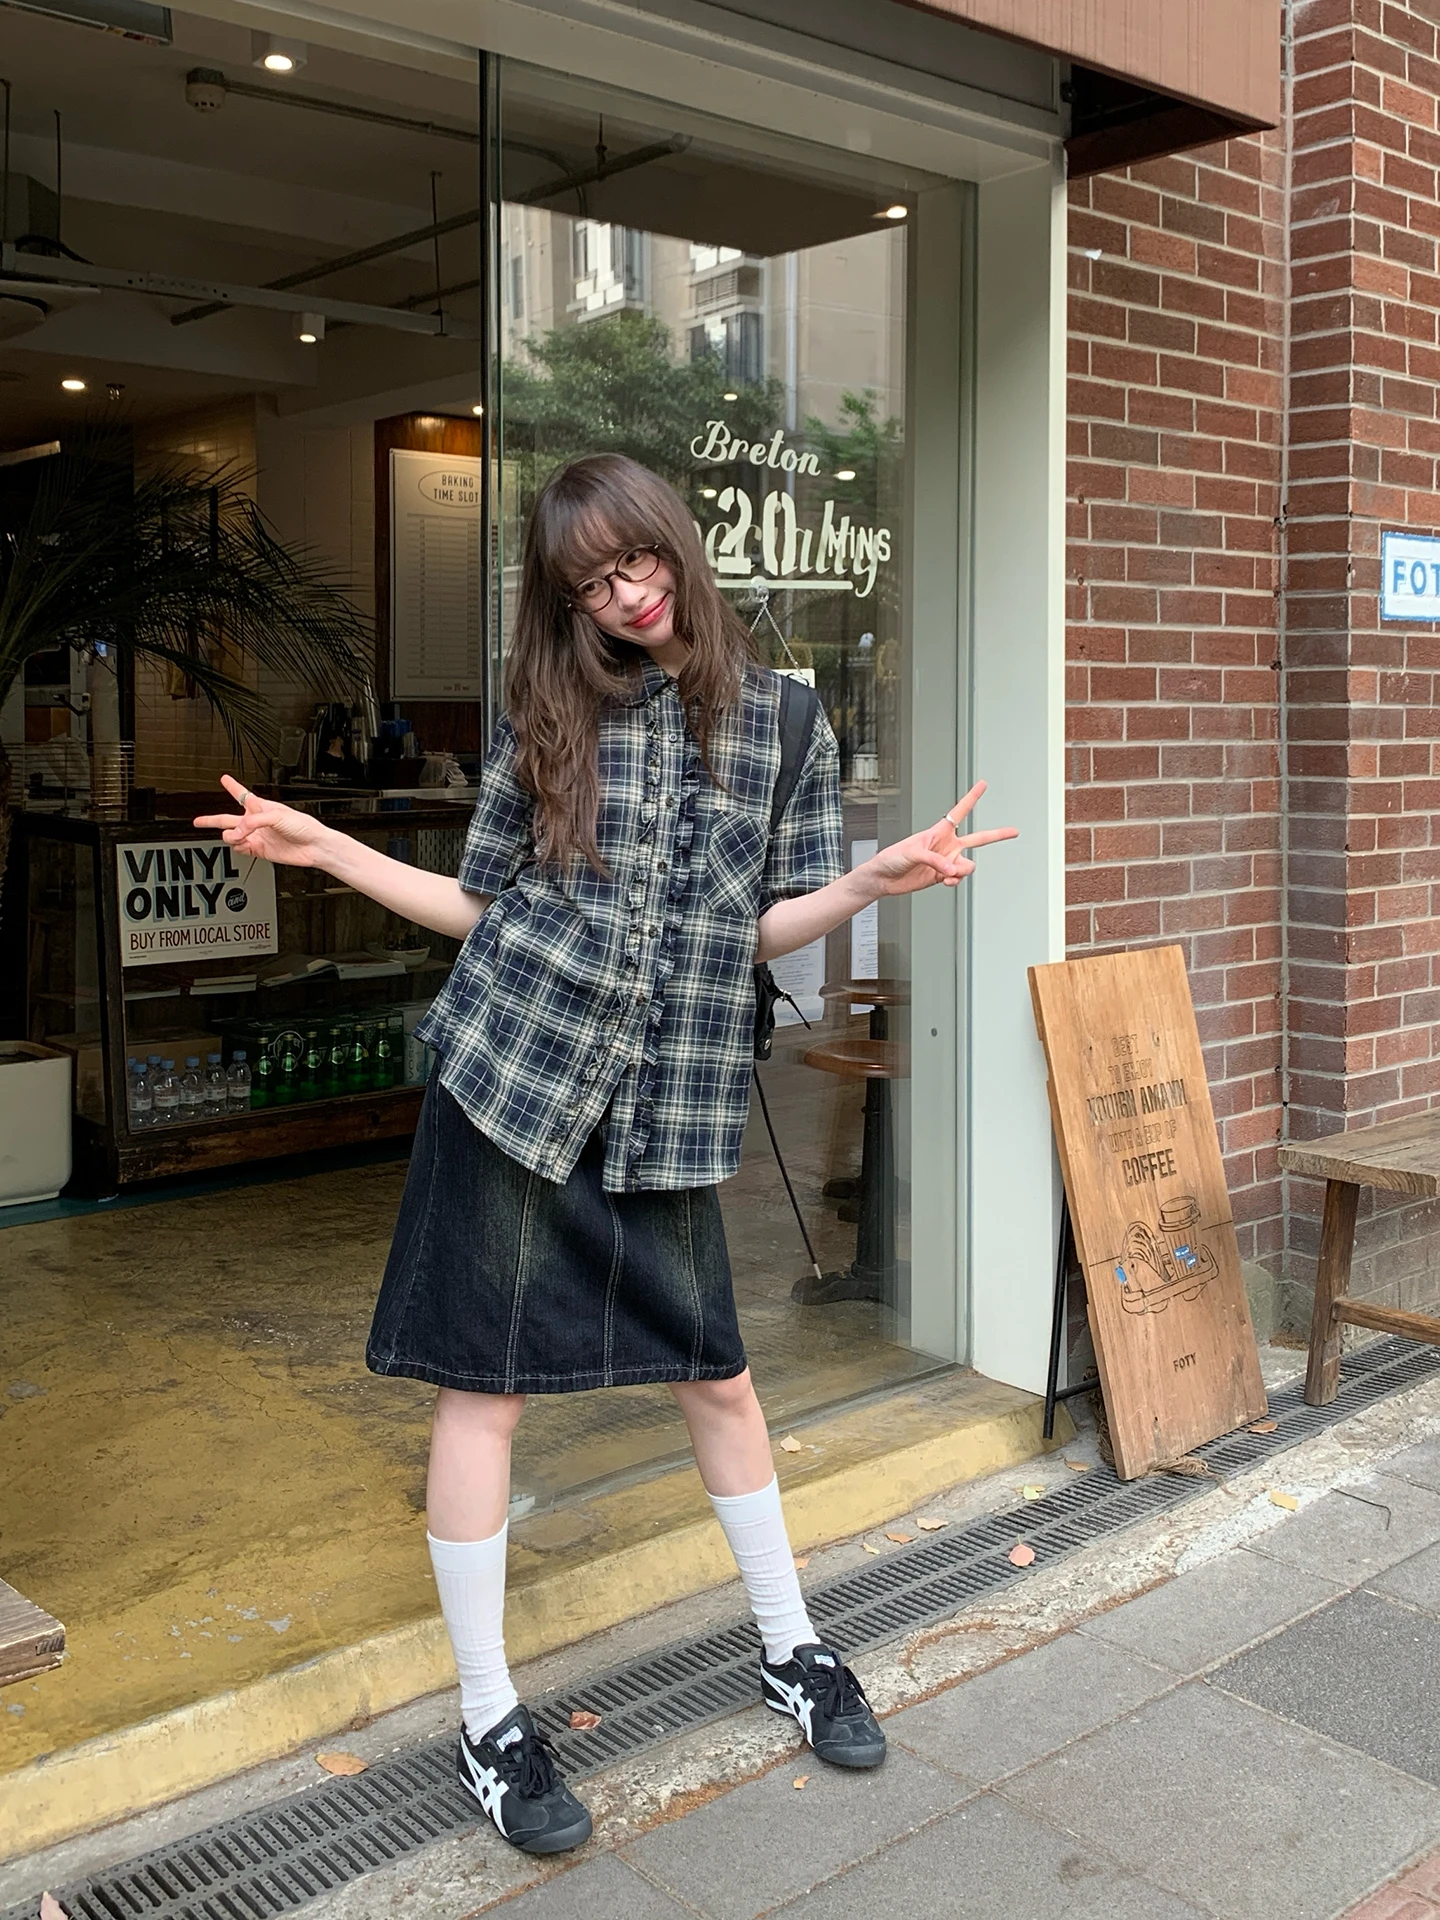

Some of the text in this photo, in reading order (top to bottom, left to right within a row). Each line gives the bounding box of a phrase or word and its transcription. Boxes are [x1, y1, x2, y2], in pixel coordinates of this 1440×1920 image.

[690, 420, 821, 477] Breton
[434, 488, 479, 503] TIME SLOT
[442, 474, 474, 488] BAKING
[717, 486, 891, 576] 20 MINS
[123, 846, 239, 886] VINYL
[123, 883, 225, 923] ONLY
[130, 923, 271, 951] BUY FROM LOCAL STORE
[1107, 1064, 1122, 1086] TO
[1140, 1078, 1188, 1115] AMANN
[1108, 1129, 1134, 1154] WITH
[1134, 1127, 1144, 1147] A
[1164, 1119, 1178, 1140] OF
[1121, 1148, 1178, 1188] COFFEE
[1173, 1352, 1197, 1374] FOTY
